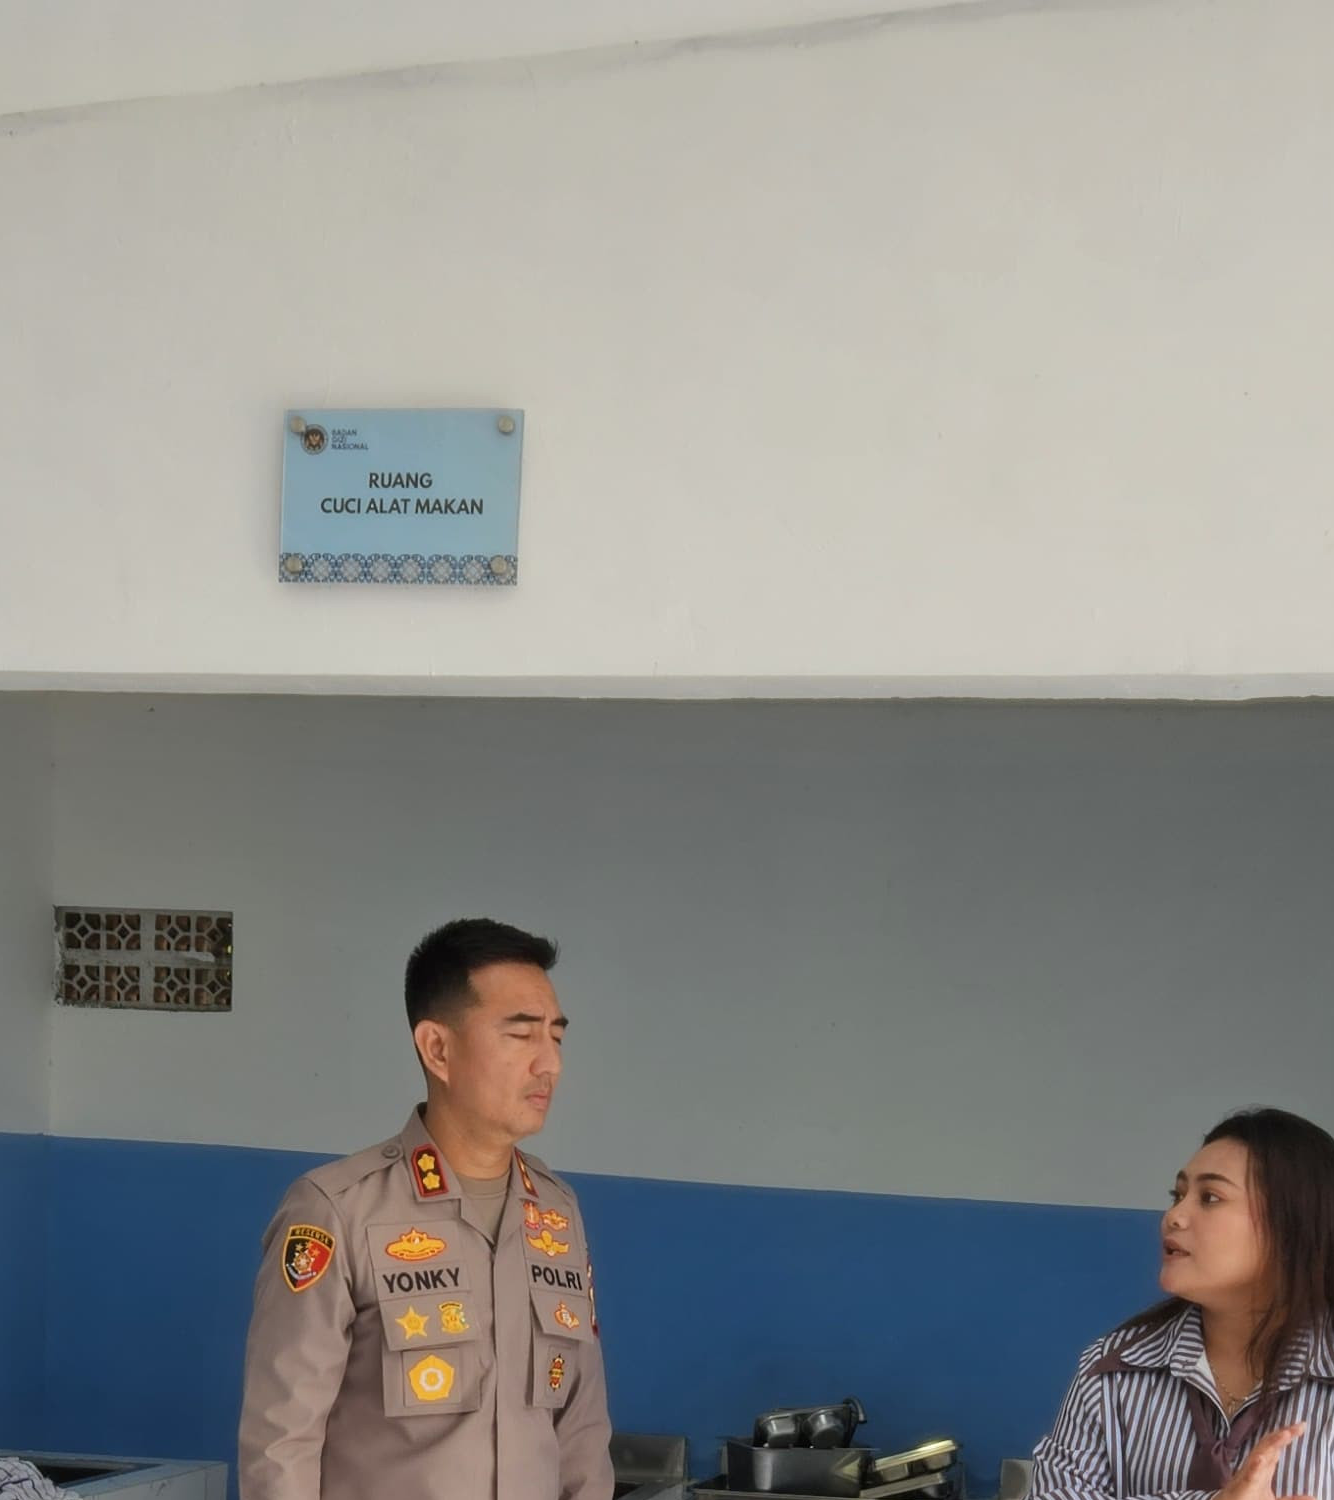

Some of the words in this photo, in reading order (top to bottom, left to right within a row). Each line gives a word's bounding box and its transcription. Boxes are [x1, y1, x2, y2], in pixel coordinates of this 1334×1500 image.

[368, 472, 433, 489] RUANG
[320, 498, 361, 514] CUCI
[365, 498, 411, 514] ALAT
[415, 498, 484, 515] MAKAN
[382, 1267, 461, 1294] YONKY
[531, 1264, 583, 1291] POLRI
